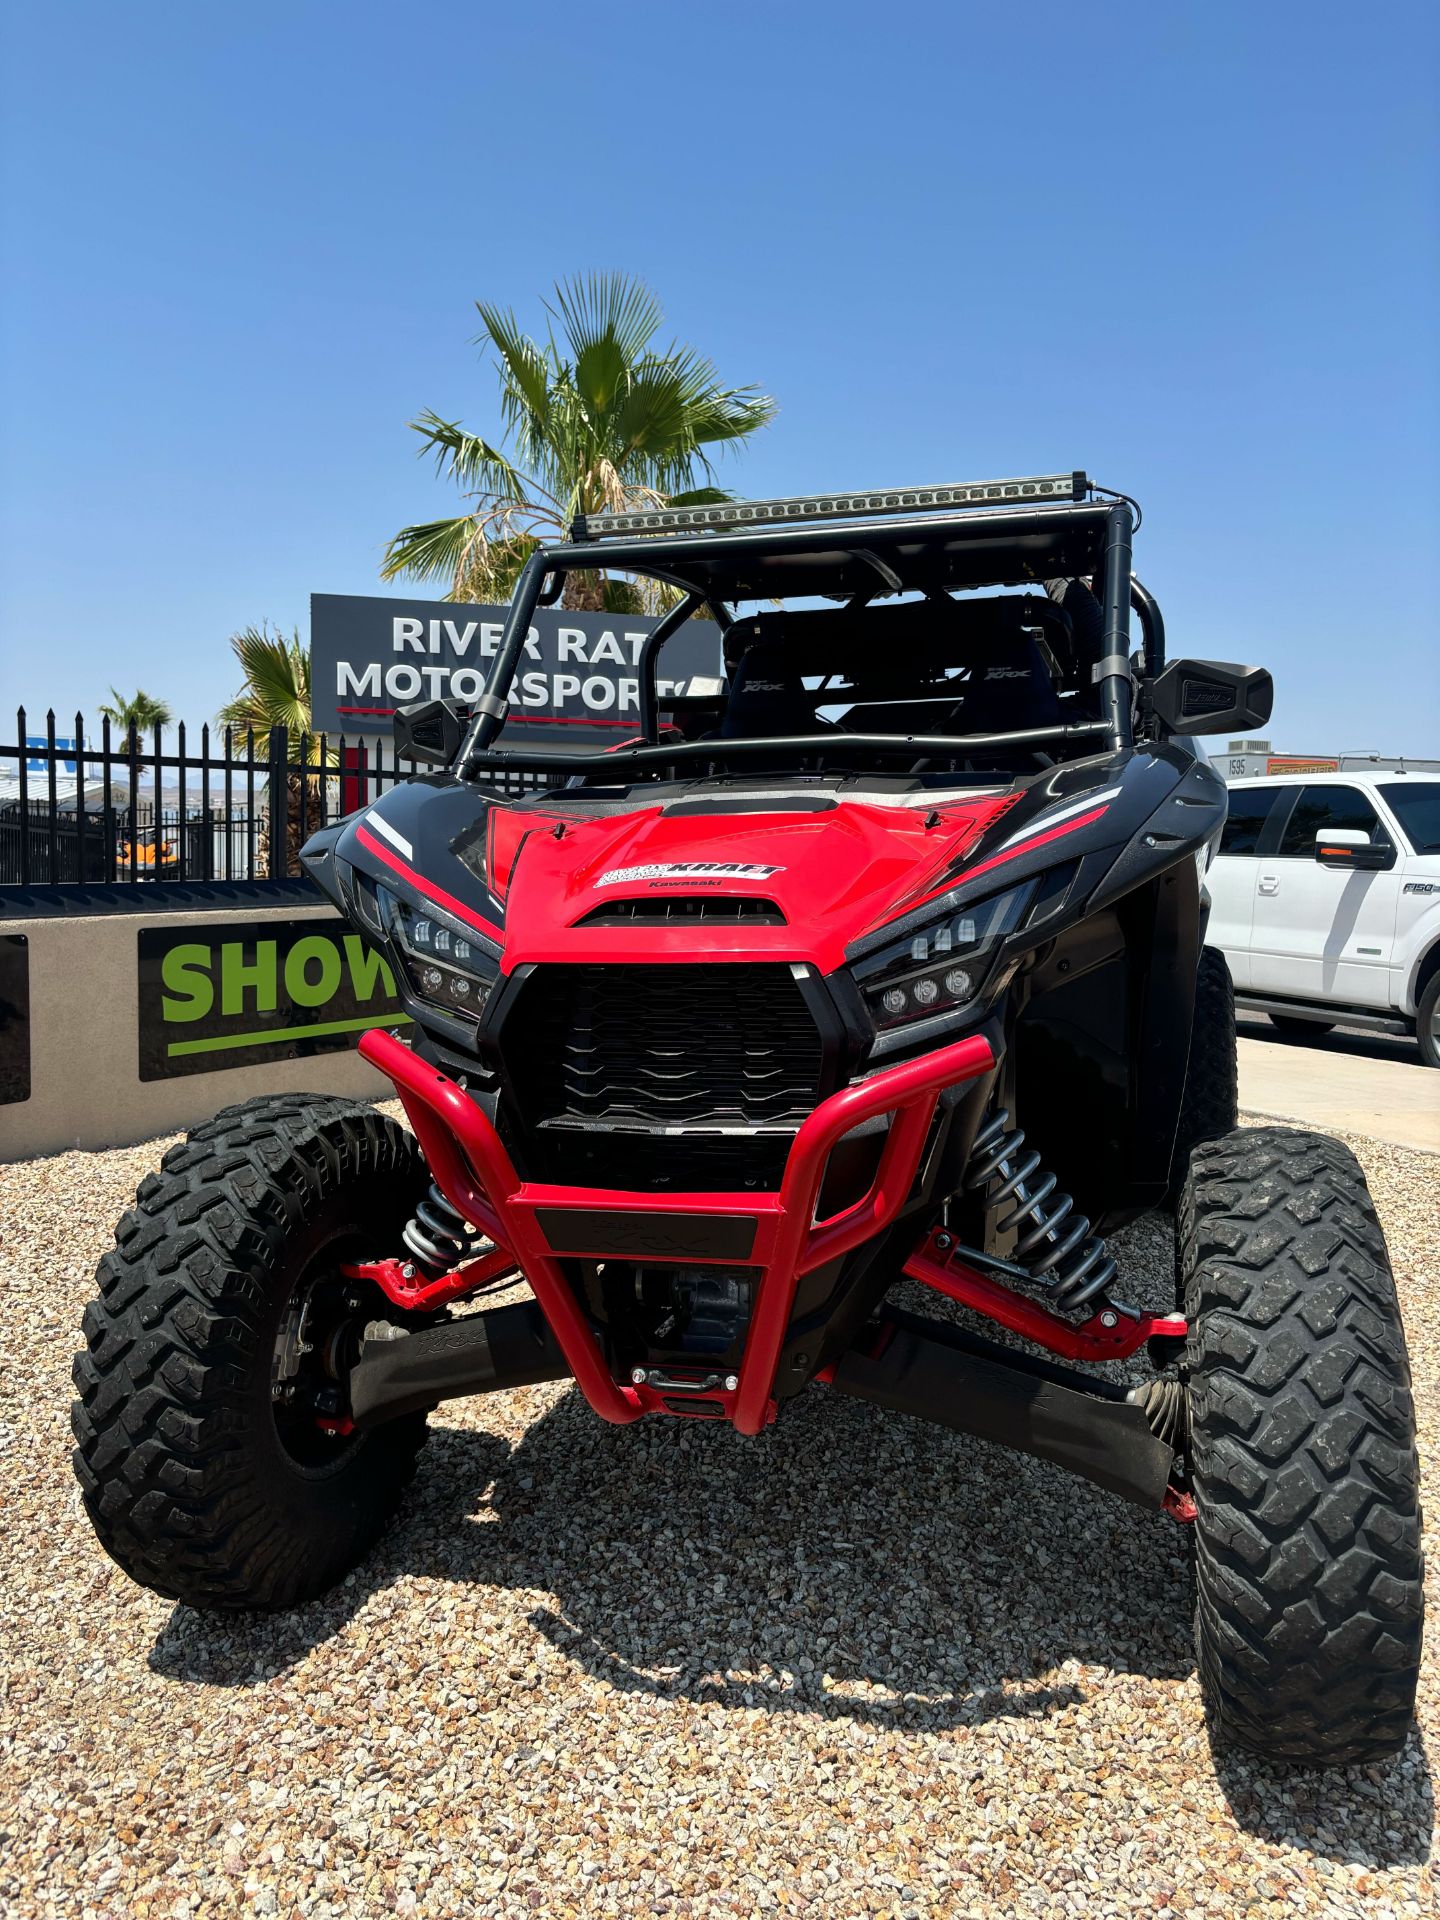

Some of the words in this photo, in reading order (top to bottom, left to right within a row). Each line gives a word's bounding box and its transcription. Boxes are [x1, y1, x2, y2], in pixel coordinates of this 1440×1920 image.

[393, 617, 542, 660] RIVER
[558, 628, 649, 667] RAT
[1229, 759, 1246, 775] 1595
[667, 862, 786, 875] KRAFT
[649, 880, 723, 888] Kawasaki
